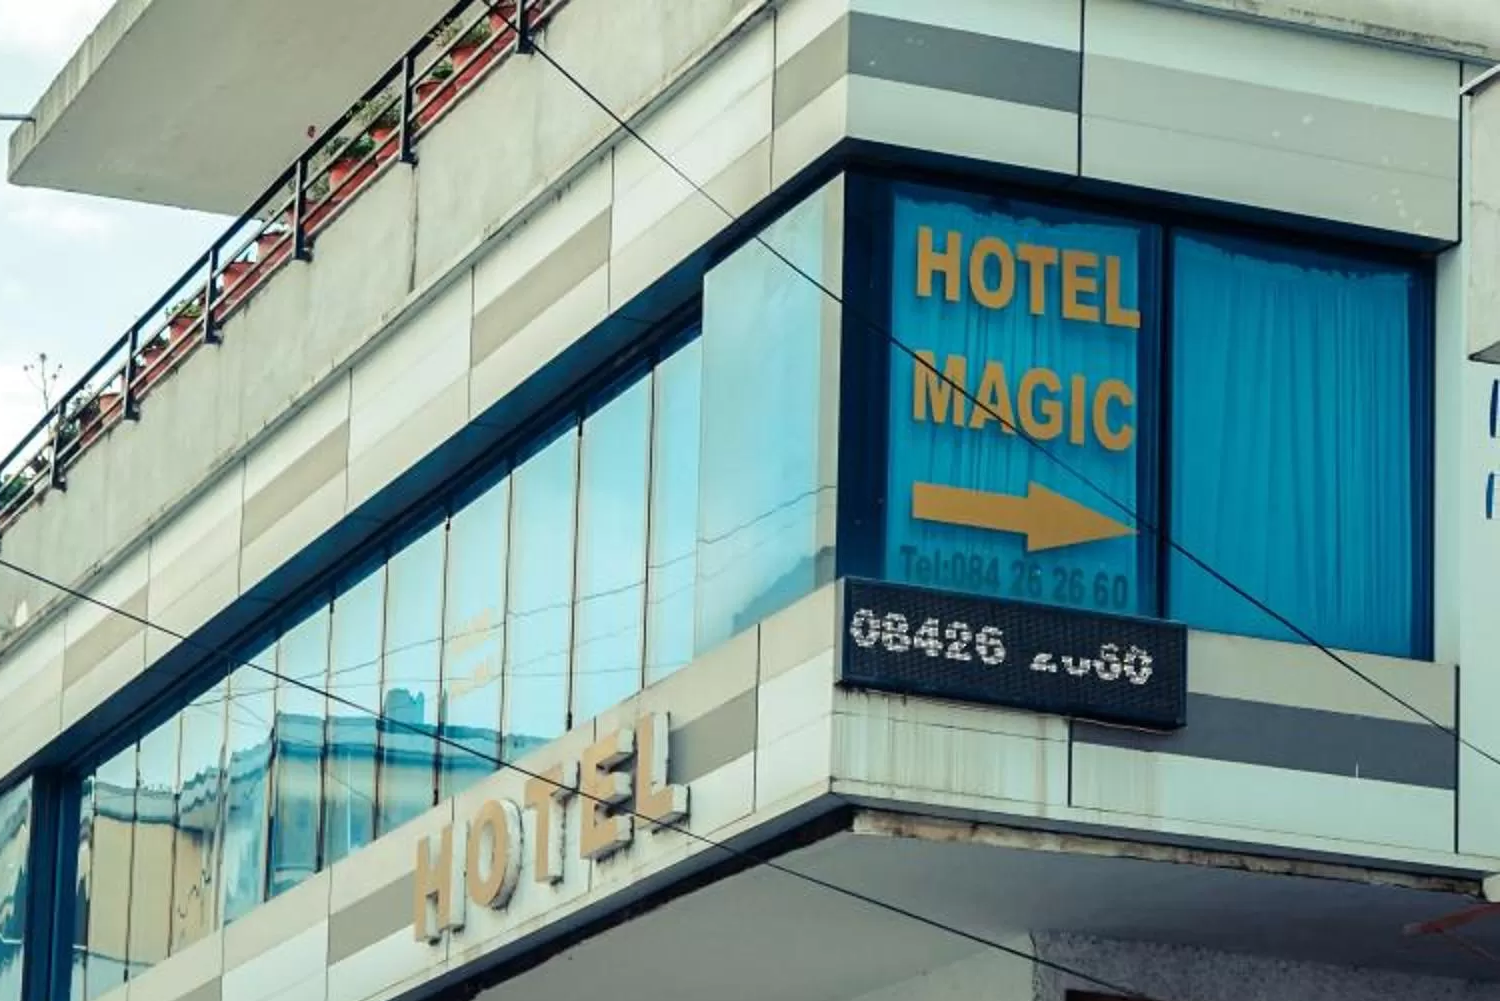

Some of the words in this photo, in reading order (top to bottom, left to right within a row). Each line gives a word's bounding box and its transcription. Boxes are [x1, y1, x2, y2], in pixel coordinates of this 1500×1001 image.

[915, 225, 1141, 329] HOTEL
[912, 349, 1135, 452] MAGIC
[1011, 559, 1043, 598] 26
[1053, 566, 1086, 605] 26
[1093, 571, 1129, 609] 60
[849, 607, 1007, 665] 08426
[414, 711, 690, 945] HOTEL
